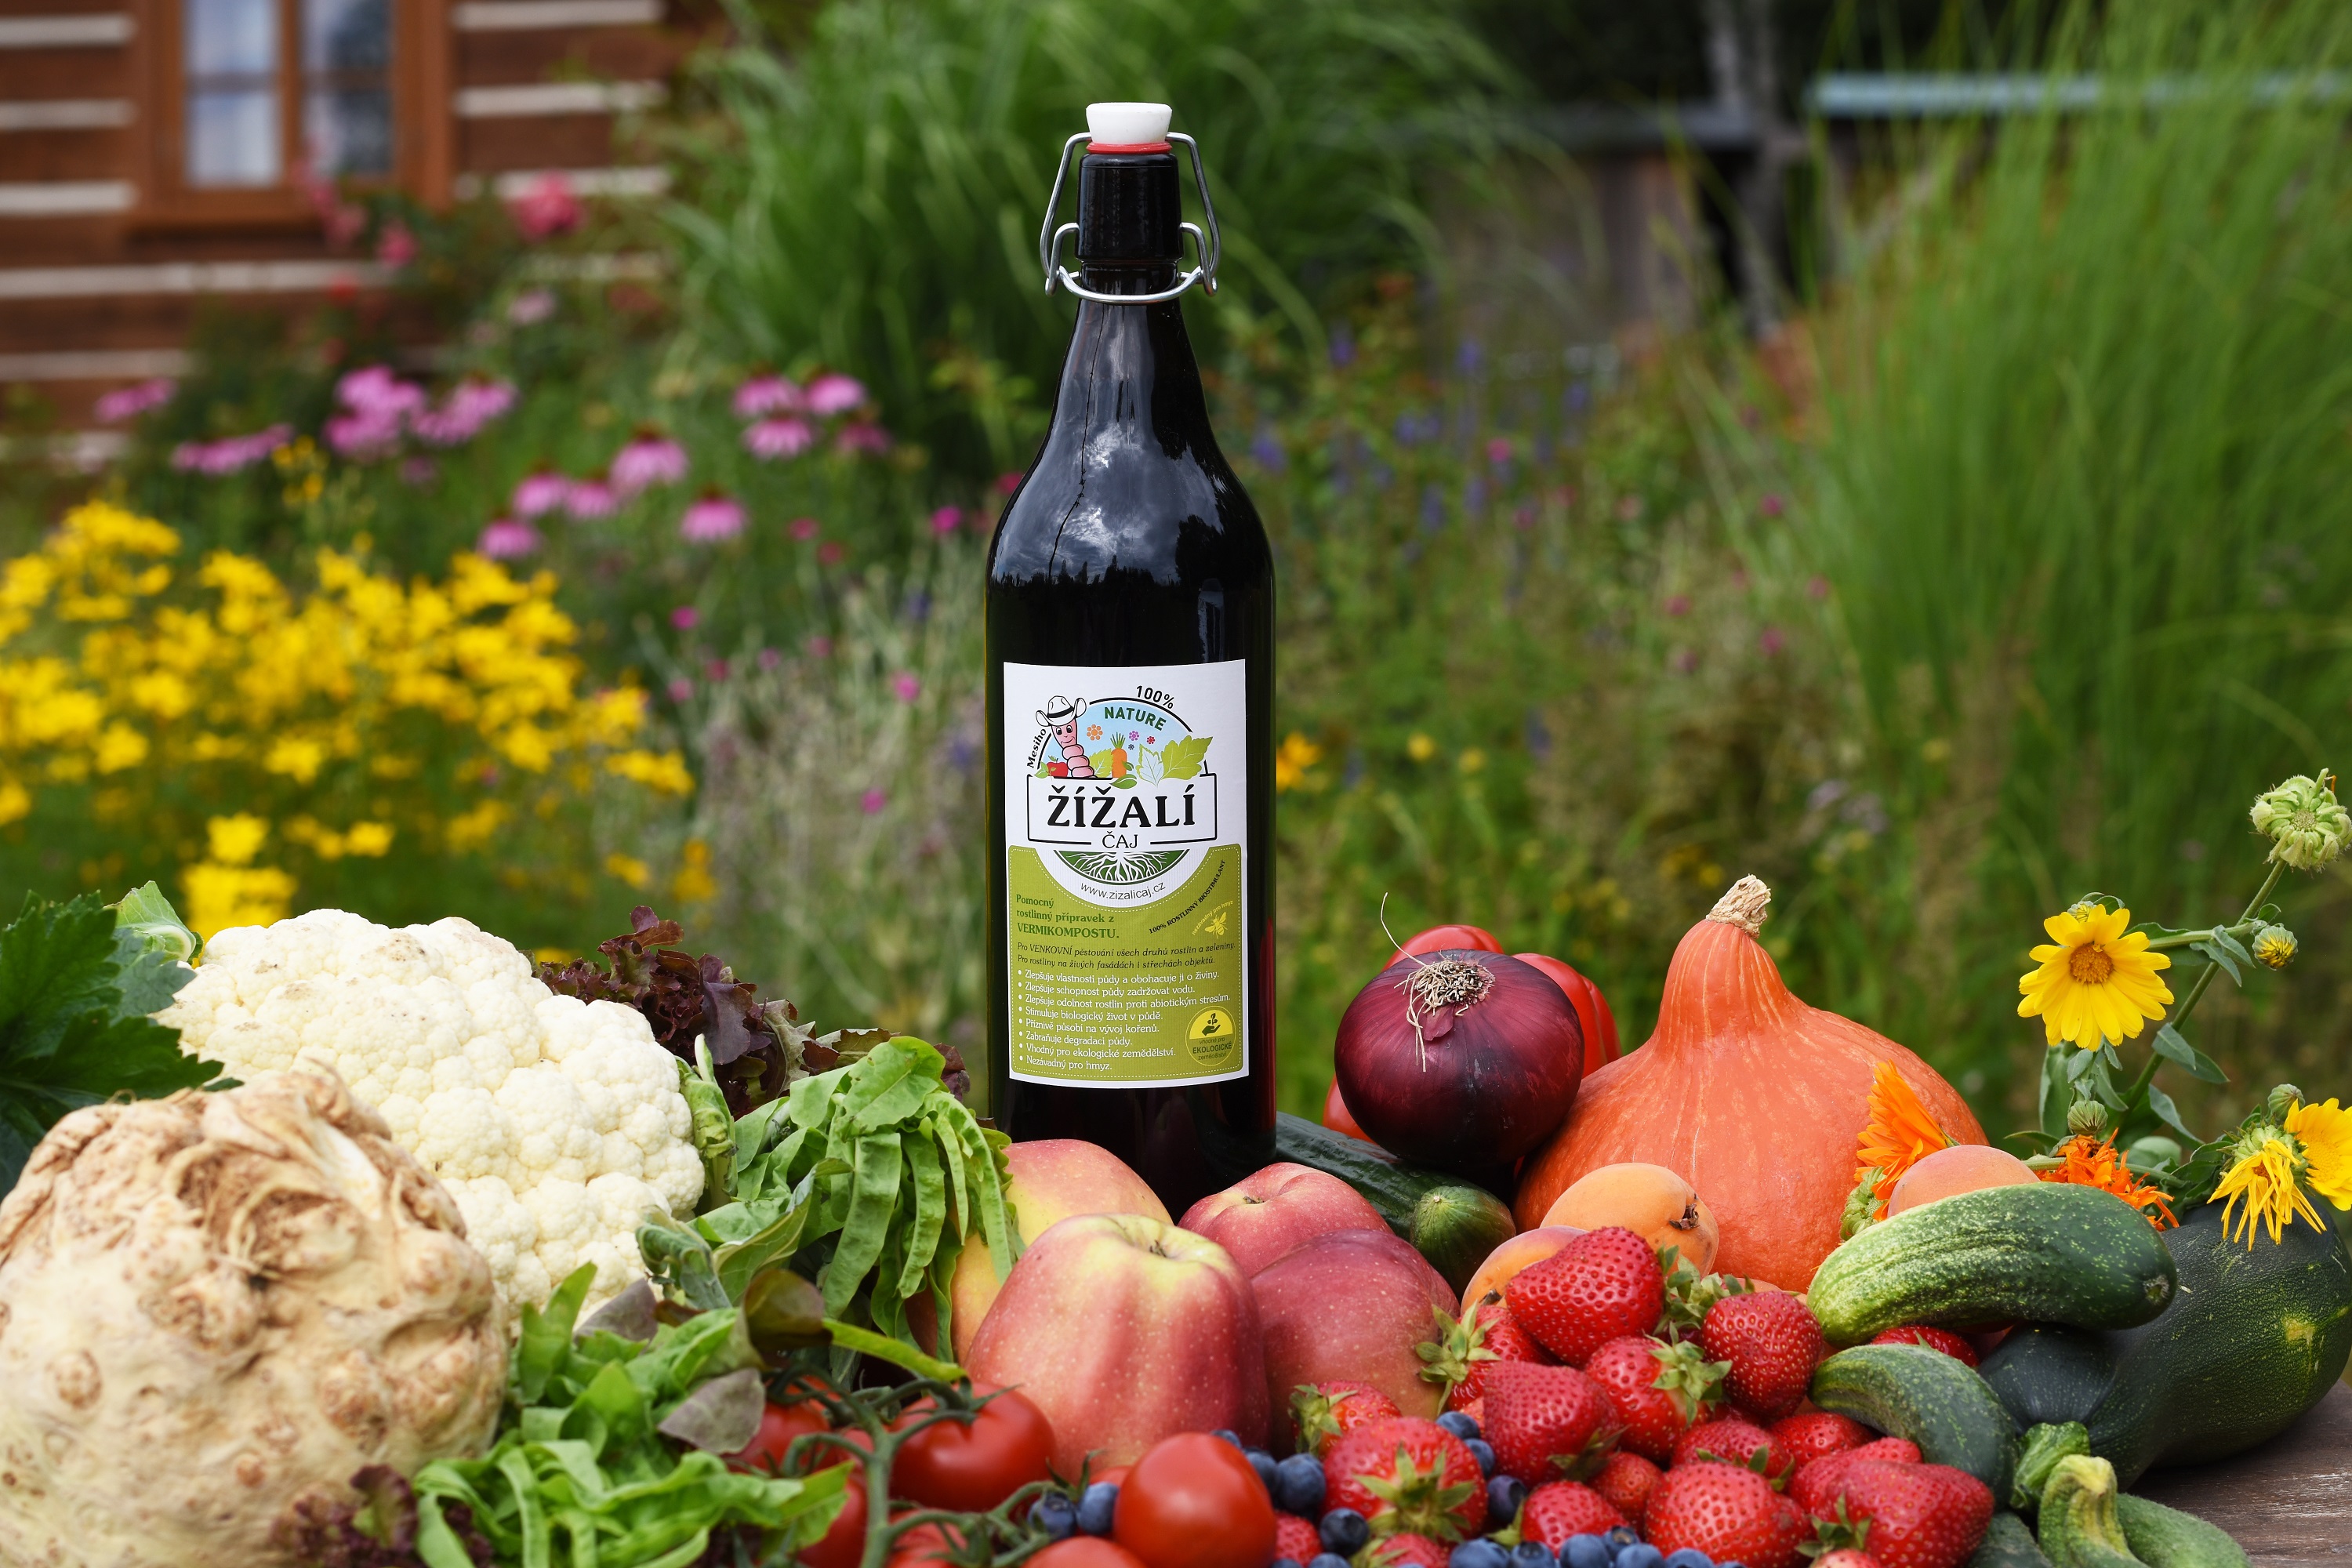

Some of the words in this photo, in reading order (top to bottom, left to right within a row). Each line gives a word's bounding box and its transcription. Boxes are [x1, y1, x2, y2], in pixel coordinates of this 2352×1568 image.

[1136, 685, 1175, 710] 100%
[1104, 706, 1167, 731] NATURE
[1027, 729, 1046, 768] Mesiho
[1047, 784, 1195, 828] ŽÍŽALÍ
[1102, 831, 1138, 849] ČAJ
[1080, 881, 1166, 900] www.zizalicaj.cz
[1149, 923, 1167, 934] 100%
[1167, 900, 1198, 926] ROSTLINNÝ
[1198, 860, 1225, 903] BIOSTIMULANT
[1016, 894, 1054, 908] Pomocný
[1016, 909, 1052, 922] rostlinný
[1056, 912, 1105, 923] přípravek
[1017, 923, 1119, 938] VERMIKOMPOSTU.
[1018, 942, 1027, 951] Pro
[1030, 944, 1073, 955] VENKOVNÍ
[1143, 947, 1168, 956] druhů
[1171, 946, 1196, 955] rostlin
[1205, 942, 1236, 951] zeleniny.
[1018, 955, 1028, 963] Pro
[1030, 958, 1055, 967] rostliny
[1069, 960, 1094, 969] živých
[1096, 960, 1134, 970] fasádách
[1142, 959, 1182, 968] střechách
[1185, 956, 1215, 967] objektů.
[1025, 969, 1054, 982] Zlepšuje
[1056, 973, 1094, 983] vlastnosti
[1098, 975, 1120, 985] půdy
[1131, 975, 1176, 984] obohacuje
[1179, 974, 1184, 983] ji
[1195, 971, 1220, 980] živiny.
[1025, 982, 1054, 995] Zlepšuje
[1056, 985, 1099, 996] schopnost
[1102, 987, 1125, 998] půdy
[1127, 987, 1169, 996] zadržovat
[1172, 985, 1195, 994] vodu.
[1025, 994, 1054, 1007] Zlepšuje
[1056, 998, 1093, 1007] odolnost
[1095, 1000, 1123, 1008] rostlin
[1126, 1000, 1148, 1010] proti
[1150, 997, 1197, 1008] abiotickým
[1199, 994, 1230, 1004] stresům.
[1025, 1006, 1058, 1020] Stimuluje
[1061, 1010, 1104, 1022] biologický
[1106, 1013, 1127, 1021] život
[1138, 1011, 1163, 1022] půdě.
[1025, 1018, 1054, 1030] Příznivě
[1056, 1024, 1083, 1033] působí
[1099, 1025, 1123, 1034] vývoj
[1125, 1024, 1160, 1033] kořenů.
[1026, 1031, 1062, 1044] Zabraňuje
[1064, 1035, 1105, 1045] degradaci
[1108, 1037, 1133, 1046] půdy.
[1026, 1043, 1054, 1056] Vhodný
[1056, 1049, 1071, 1057] pro
[1073, 1048, 1120, 1059] ekologické
[1122, 1047, 1176, 1058] zemědělství.
[1193, 1041, 1232, 1054] EKOLOGICKÉ
[1026, 1055, 1066, 1069] Nezávadný
[1068, 1061, 1083, 1070] pro
[1086, 1061, 1112, 1071] hmyz.
